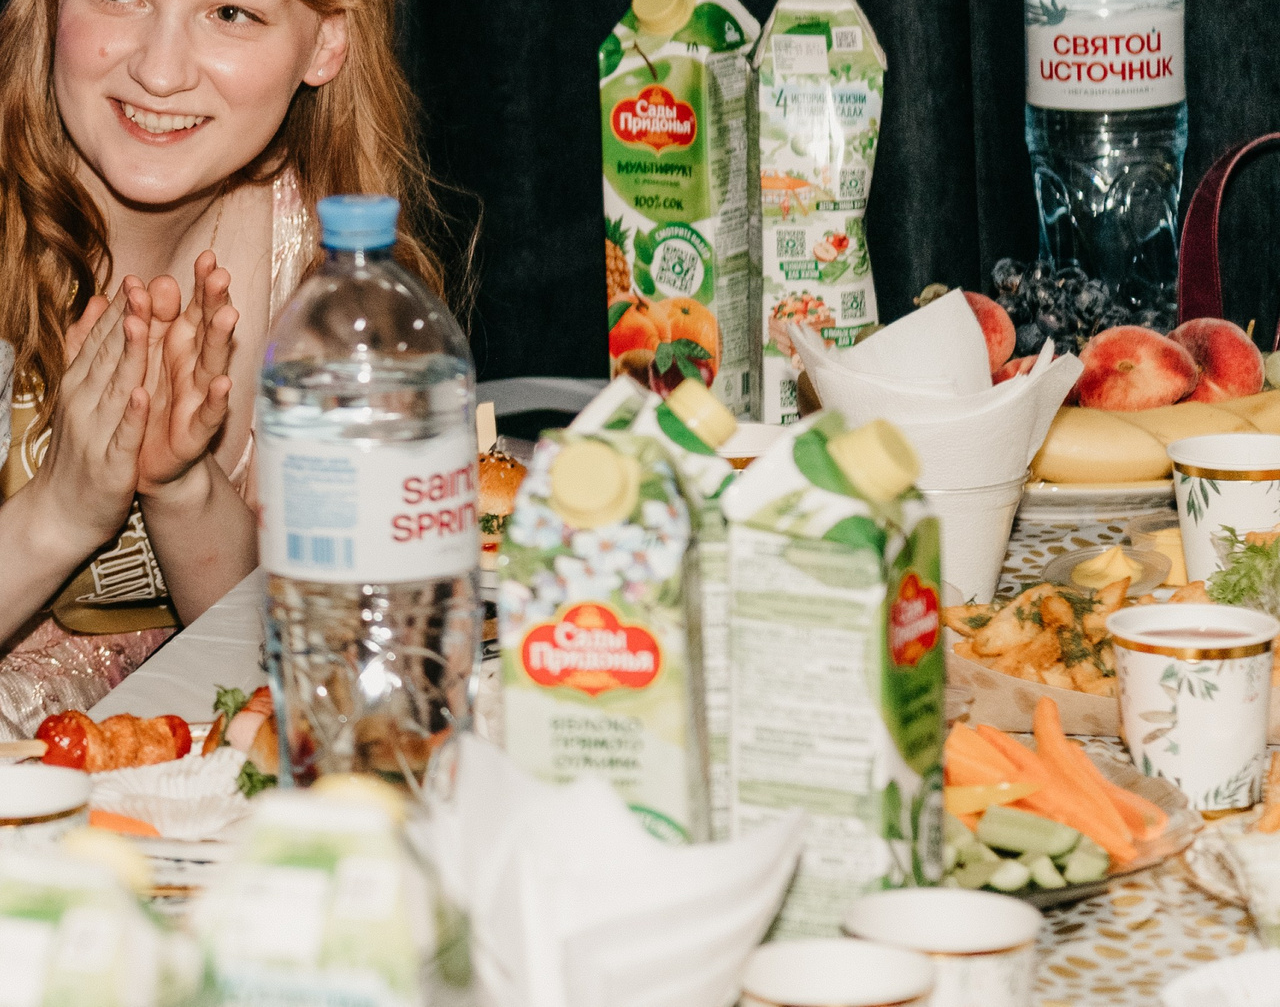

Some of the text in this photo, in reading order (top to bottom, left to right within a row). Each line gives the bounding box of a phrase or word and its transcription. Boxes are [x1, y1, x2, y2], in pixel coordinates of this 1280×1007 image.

[1053, 26, 1162, 56] СВЯТОЙ
[1040, 55, 1174, 83] ИСТОЧНИК
[635, 99, 677, 119] Сады
[775, 88, 867, 118] 4 ИСТОРИ ЖИЗНИ
[619, 111, 691, 135] Придонья
[391, 501, 478, 543] SPRIN
